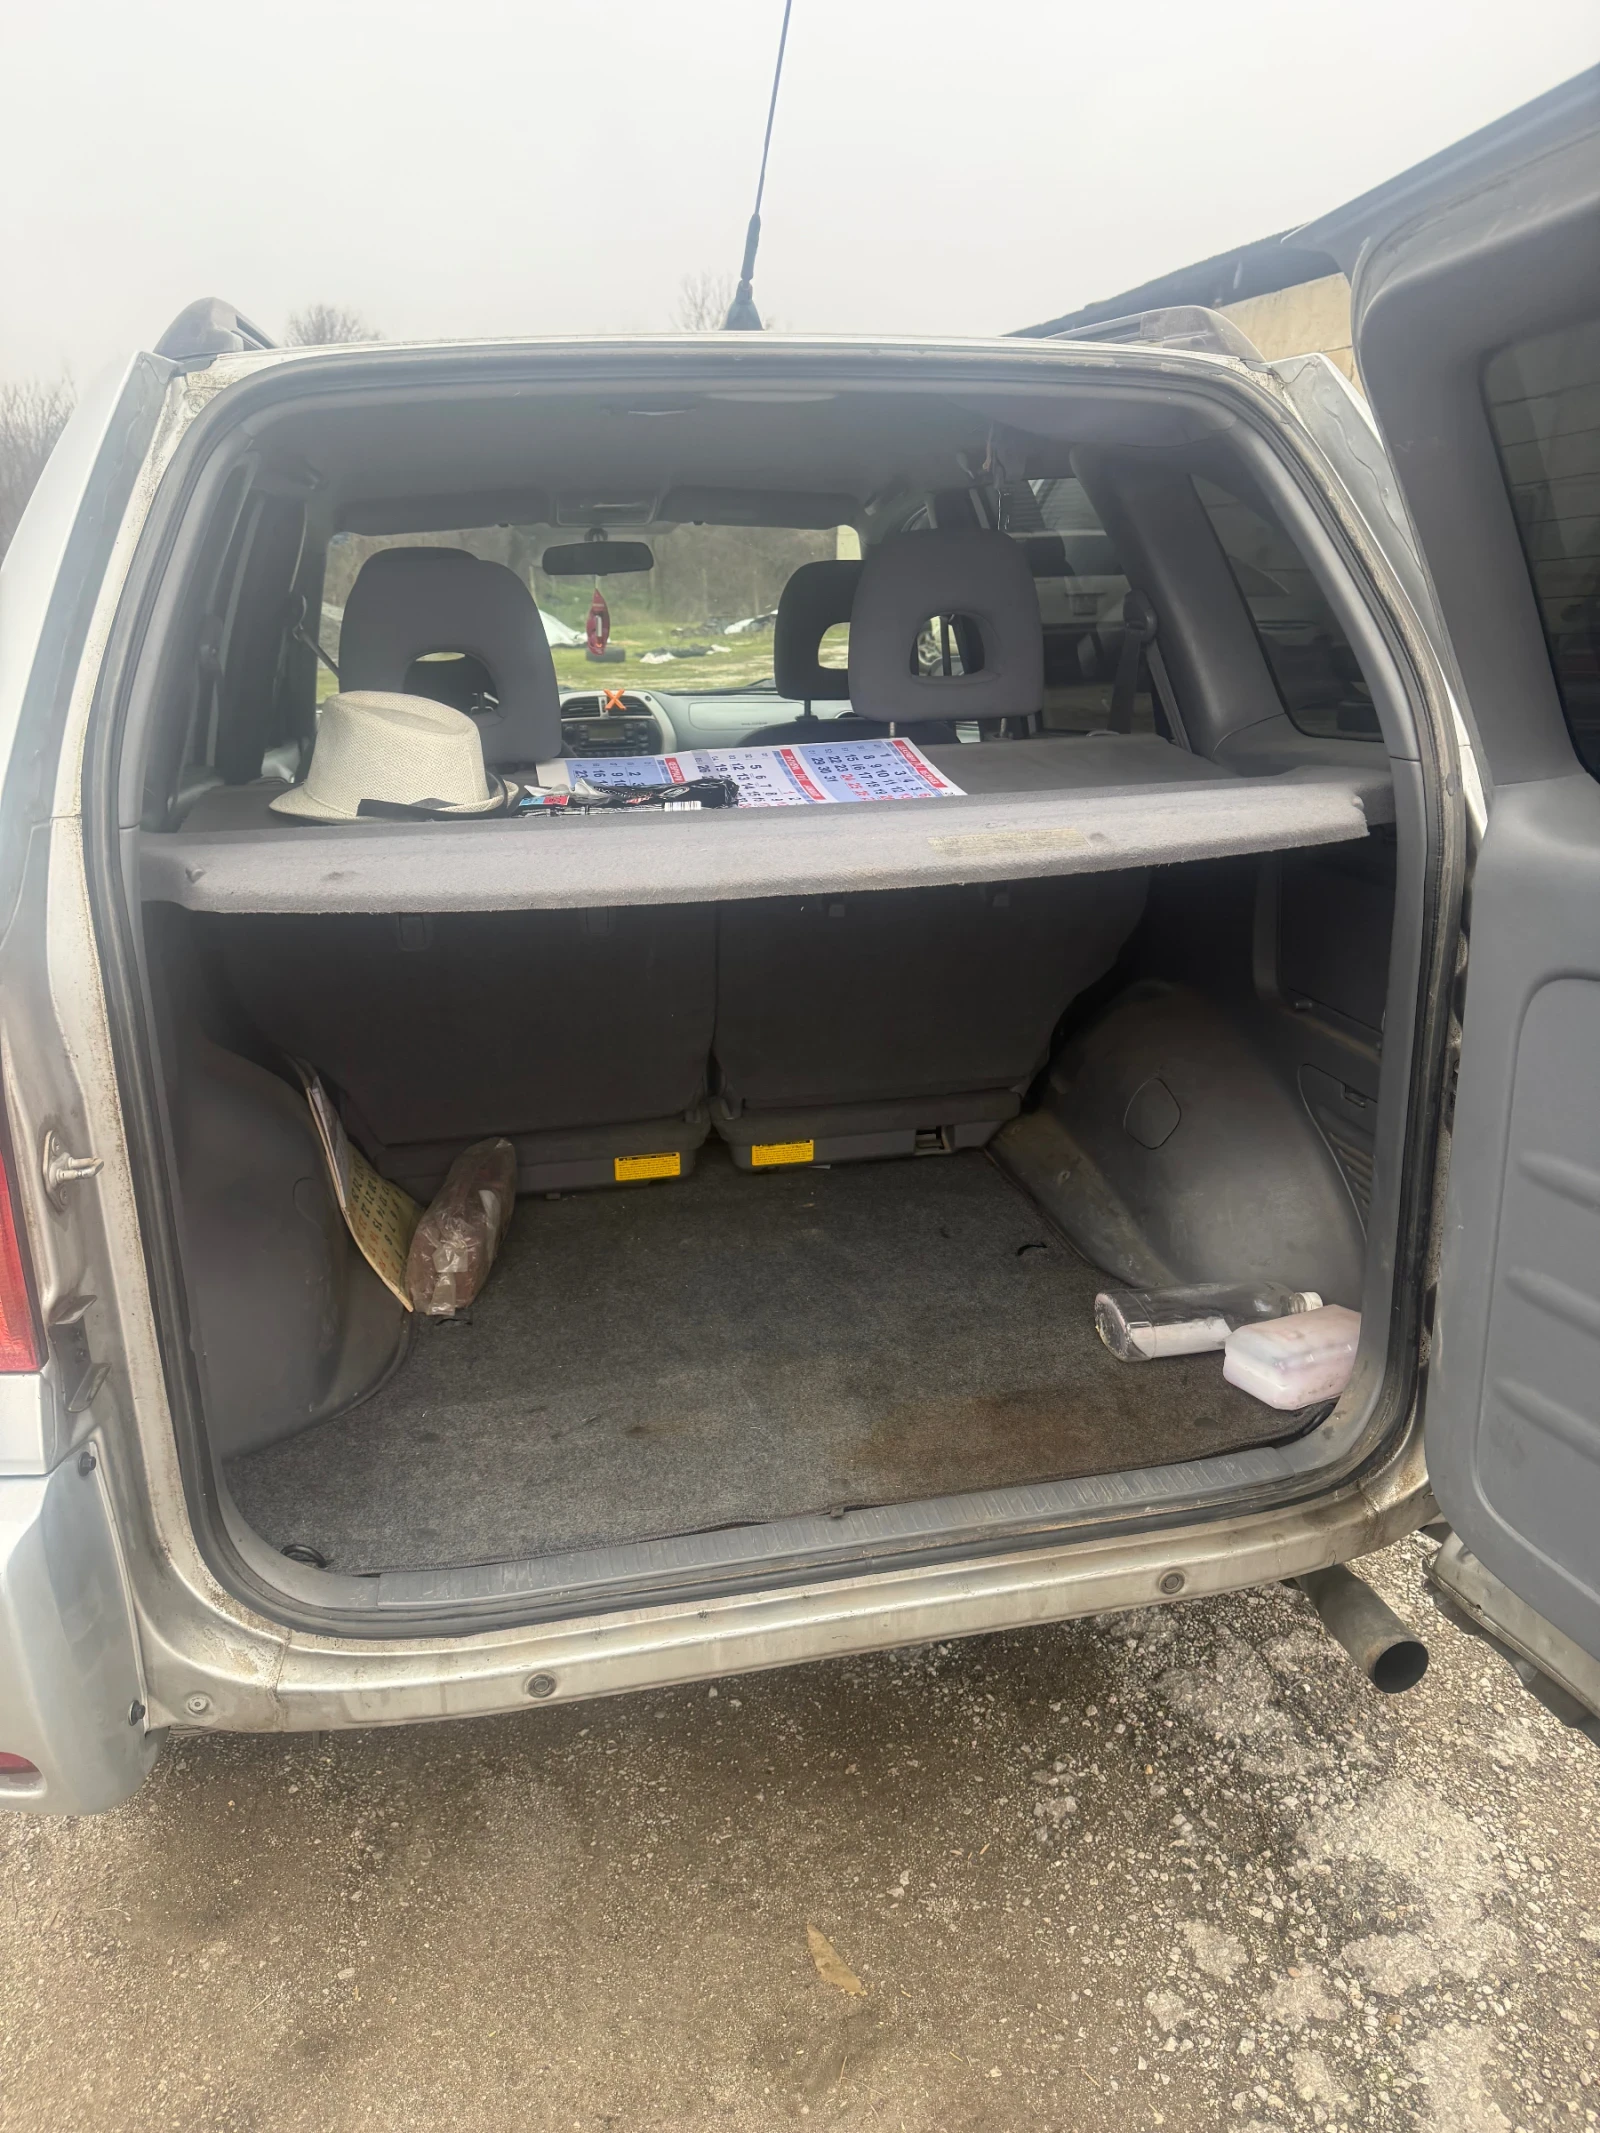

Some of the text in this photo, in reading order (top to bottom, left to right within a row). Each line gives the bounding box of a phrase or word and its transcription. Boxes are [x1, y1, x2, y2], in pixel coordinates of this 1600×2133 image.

[697, 765, 711, 773] 26
[364, 1192, 374, 1205] 21
[361, 1204, 370, 1218] 22
[376, 1205, 385, 1218] 14
[373, 1218, 382, 1231] 15
[387, 1222, 395, 1233] 7
[384, 1235, 392, 1245] 8
